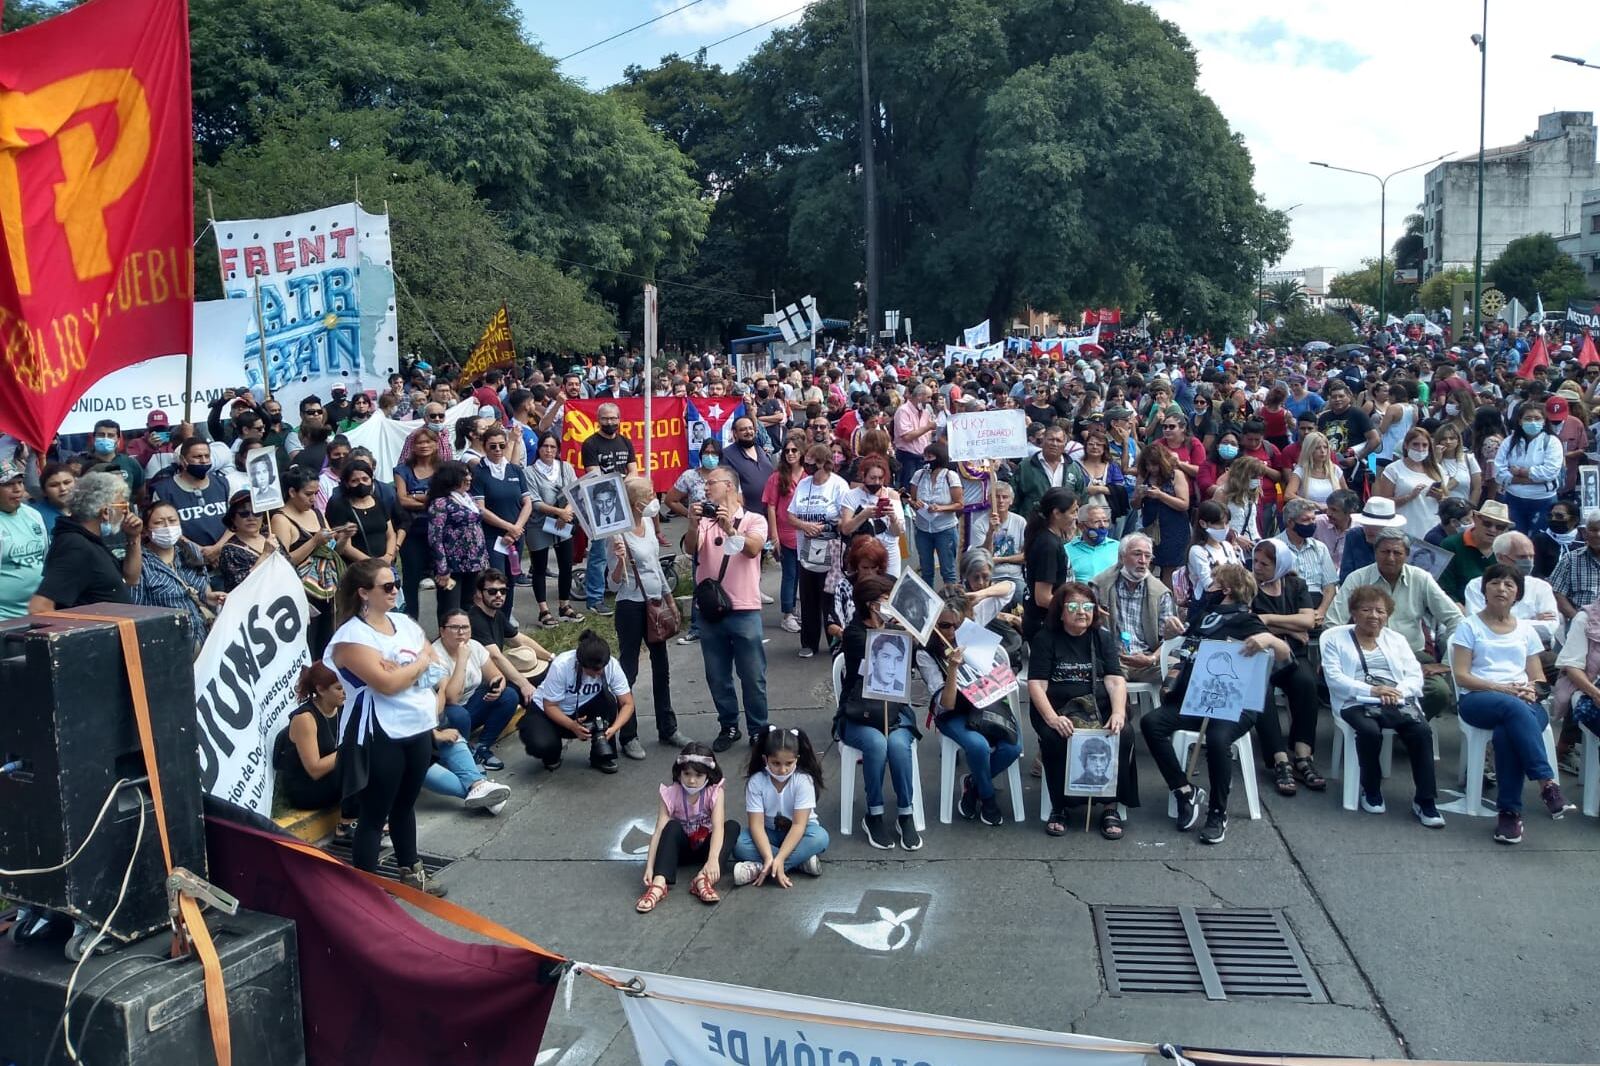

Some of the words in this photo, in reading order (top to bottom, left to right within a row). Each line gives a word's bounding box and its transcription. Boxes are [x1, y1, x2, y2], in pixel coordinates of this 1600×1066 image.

[220, 227, 355, 281] FRENT
[107, 247, 192, 316] UEBL
[227, 266, 359, 328] ATR
[71, 397, 126, 413] UNIDAD
[132, 396, 153, 410] ES
[158, 394, 179, 408] EL
[594, 417, 681, 439] RTDO
[952, 418, 985, 431] KUKY
[177, 501, 227, 521] UPCN
[241, 764, 255, 781] de
